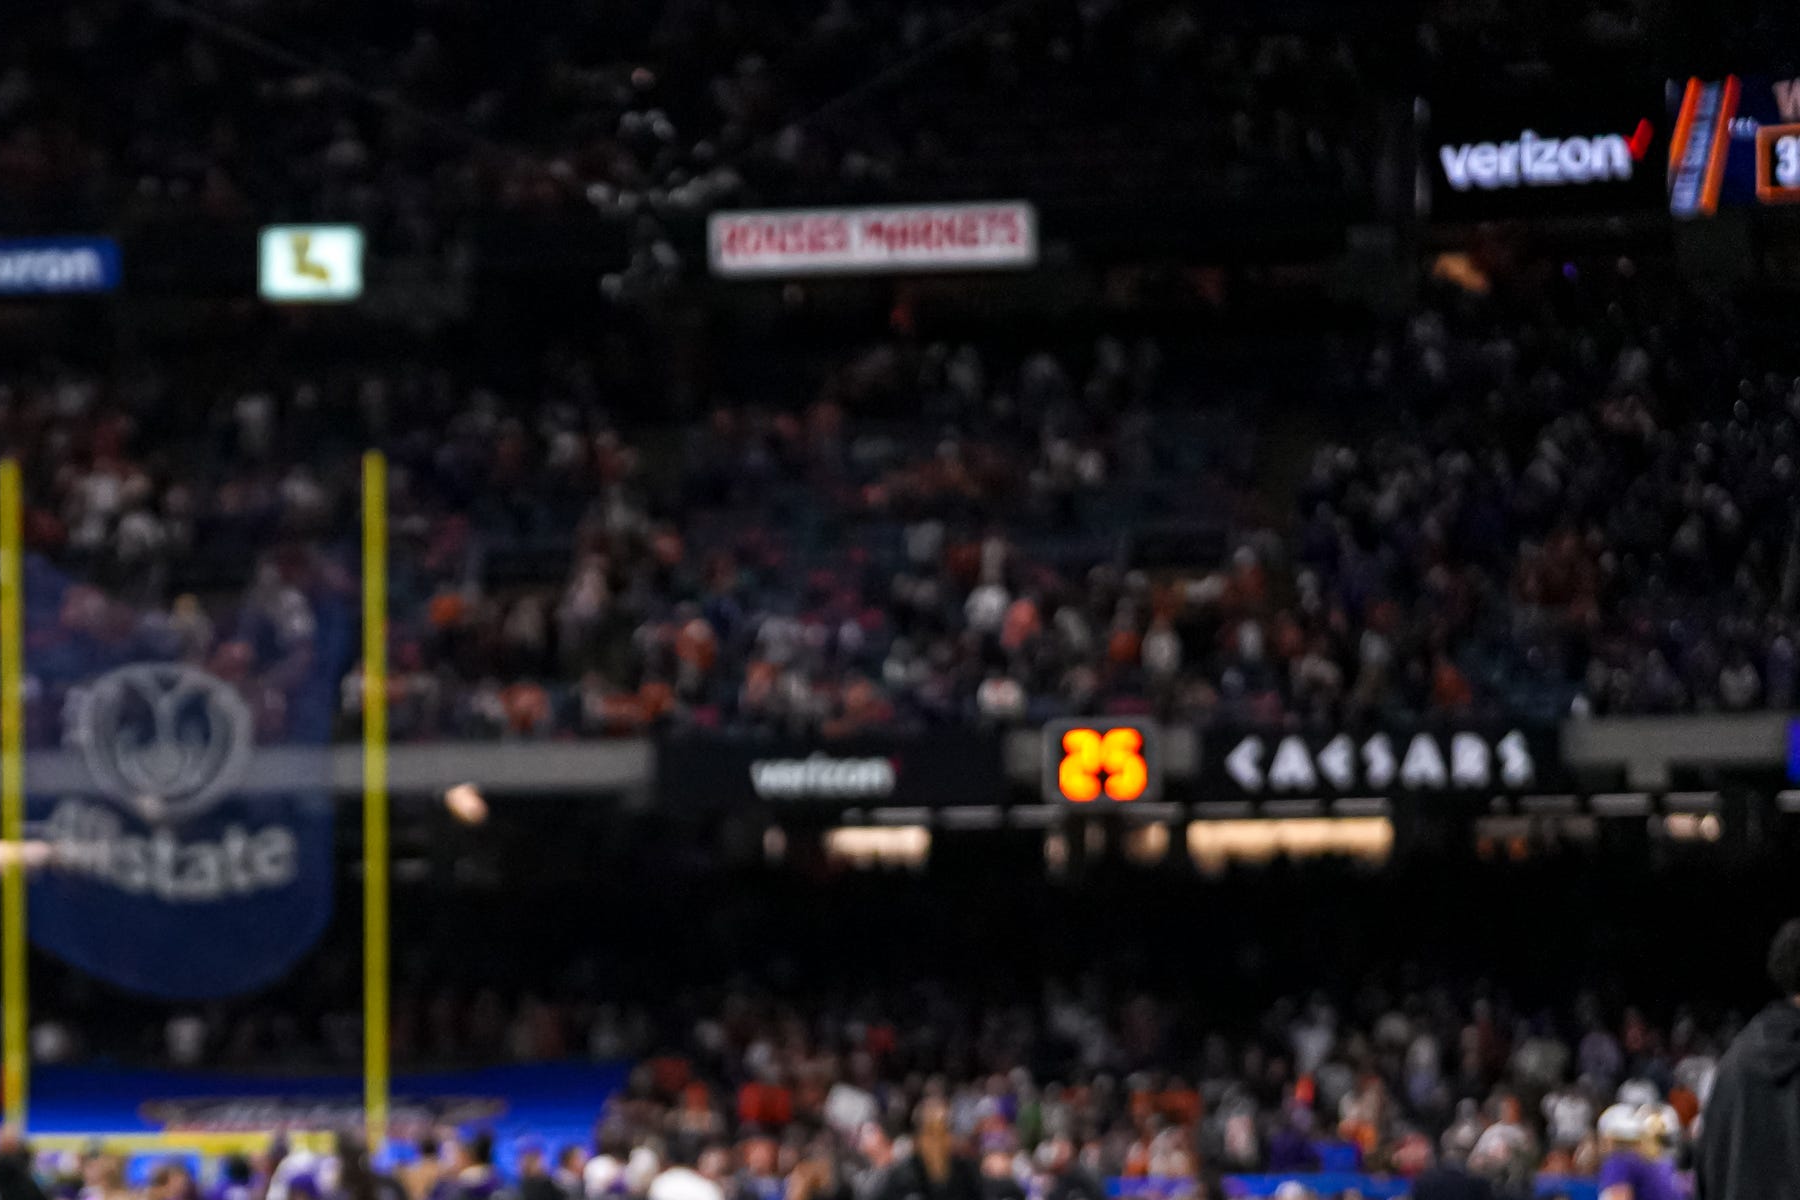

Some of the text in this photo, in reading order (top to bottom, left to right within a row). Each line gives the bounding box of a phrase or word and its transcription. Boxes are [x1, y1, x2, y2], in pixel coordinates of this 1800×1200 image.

[1440, 128, 1634, 191] verizon
[1775, 134, 1800, 189] 3
[1058, 727, 1149, 803] 25
[1225, 730, 1533, 791] CAESARS
